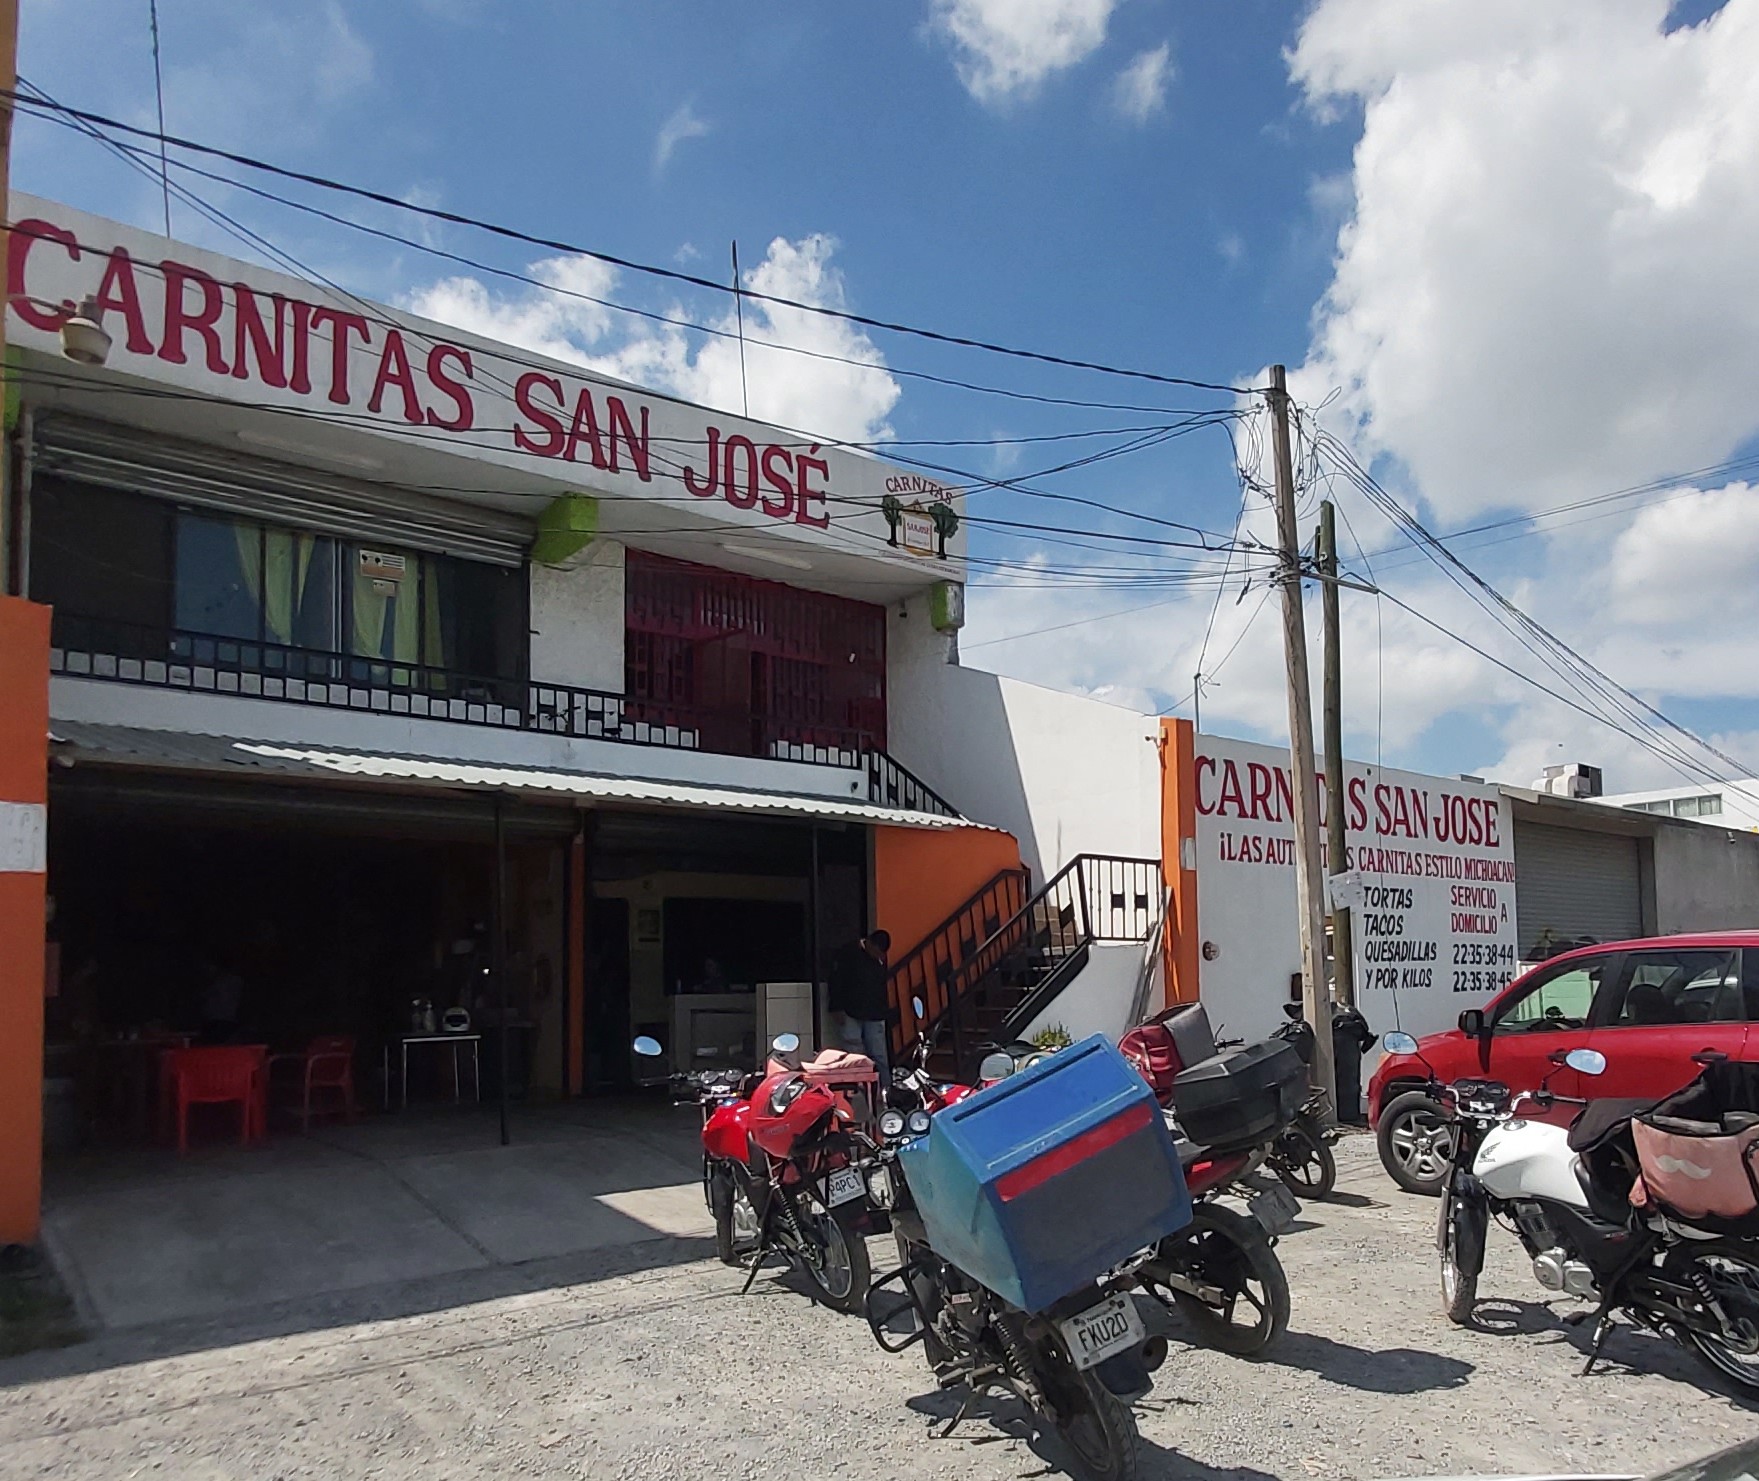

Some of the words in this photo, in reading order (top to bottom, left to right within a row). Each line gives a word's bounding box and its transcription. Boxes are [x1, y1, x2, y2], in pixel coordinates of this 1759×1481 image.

[8, 218, 474, 432] CARNITAS
[514, 372, 652, 482] SAN
[684, 426, 830, 530] JOSÉ
[886, 476, 953, 506] CARNITAS
[1374, 783, 1428, 839] SAN
[1433, 793, 1500, 848] JOSE
[1358, 846, 1422, 877] CARNITAS
[1425, 853, 1462, 880] ESTILO
[1363, 886, 1413, 910] TORTAS
[1450, 885, 1497, 910] SERVICIO
[1501, 903, 1508, 923] A
[1363, 913, 1404, 937] TACOS
[1451, 912, 1498, 935] DOMICILIO
[1364, 940, 1437, 964] QUESADILLAS
[1365, 968, 1374, 990] Y
[1375, 967, 1398, 990] POR
[1401, 967, 1433, 989] KILOS
